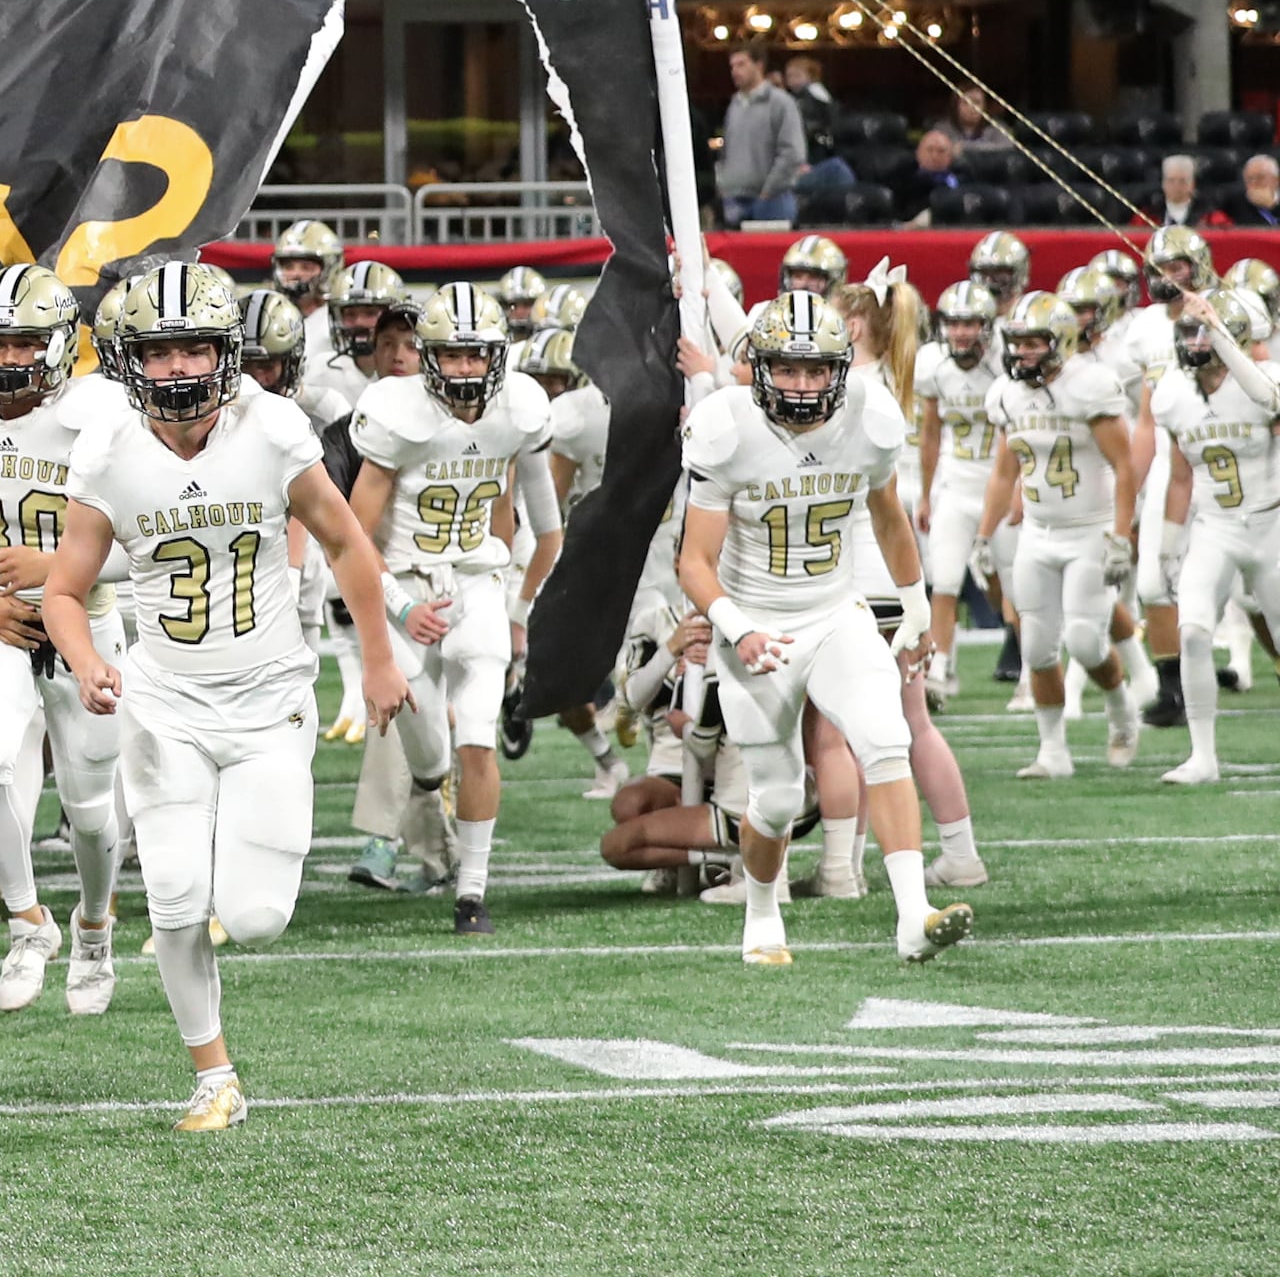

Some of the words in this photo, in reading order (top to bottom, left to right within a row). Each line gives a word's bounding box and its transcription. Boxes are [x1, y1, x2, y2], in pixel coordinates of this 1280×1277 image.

[425, 456, 507, 480] CALHOUN
[747, 472, 863, 500] CALHOUN
[1202, 444, 1245, 509] 9
[137, 501, 264, 538] CALHOUN
[760, 498, 854, 577] 15
[152, 530, 261, 644] 31
